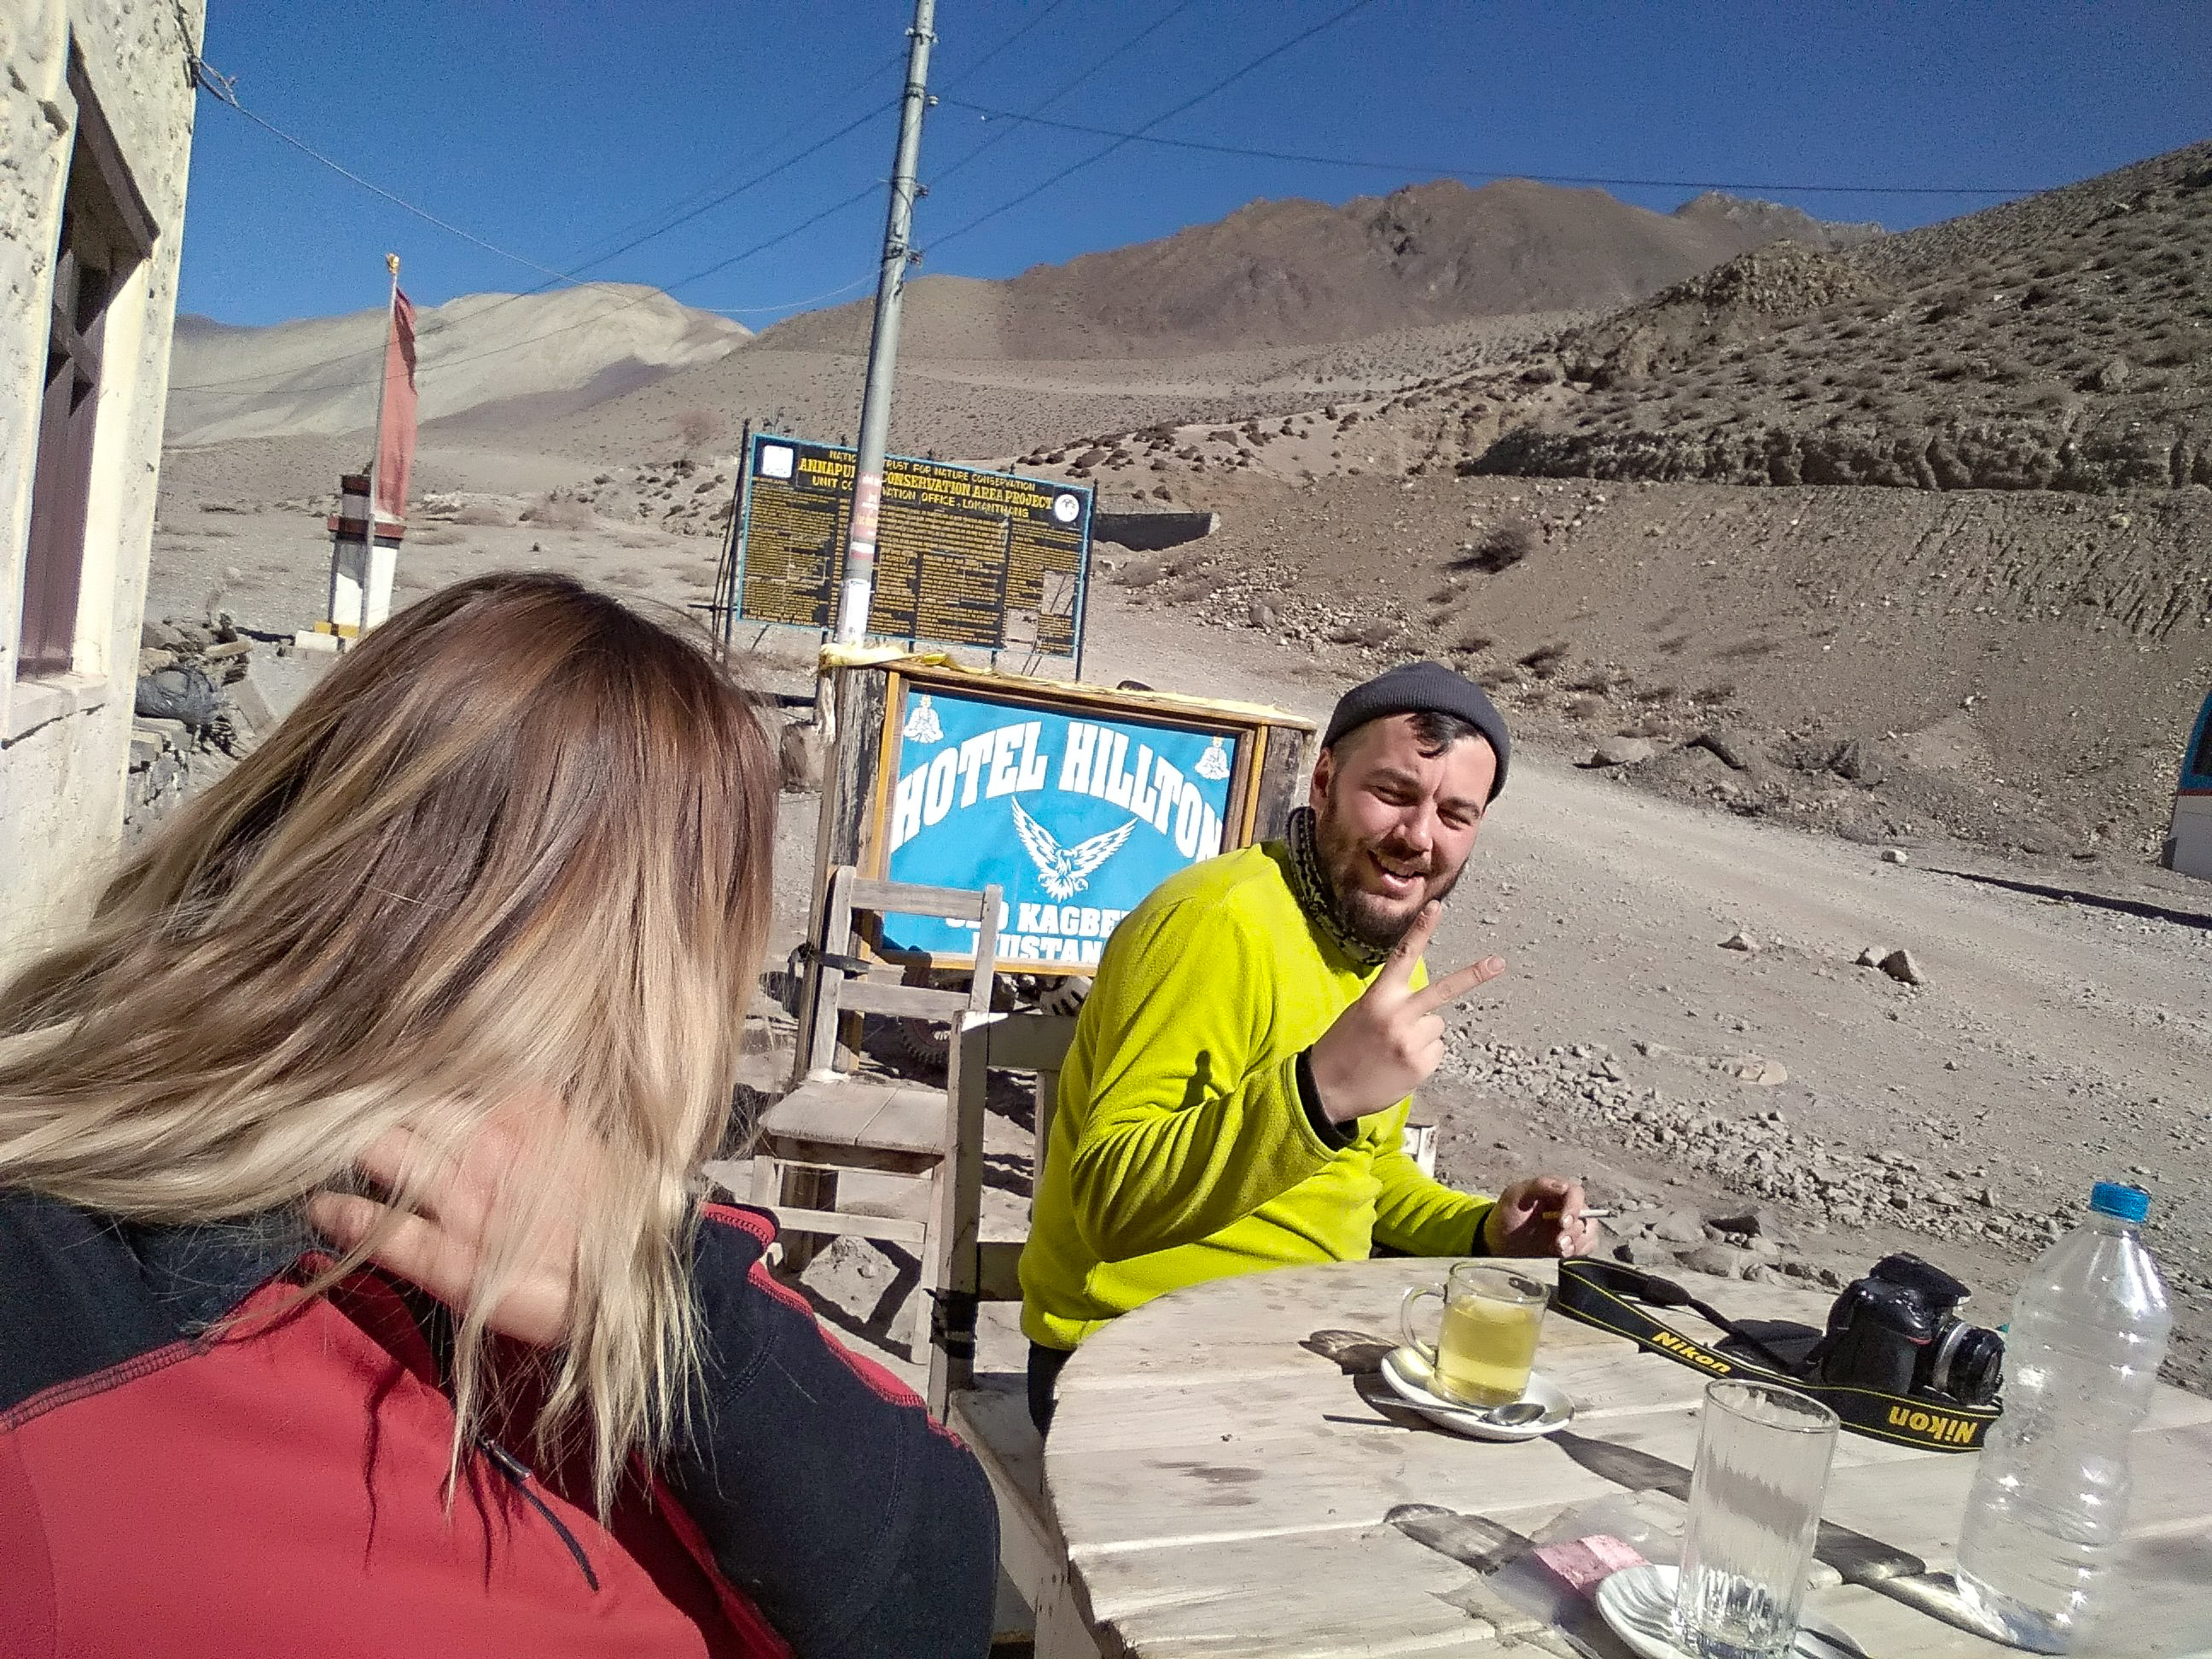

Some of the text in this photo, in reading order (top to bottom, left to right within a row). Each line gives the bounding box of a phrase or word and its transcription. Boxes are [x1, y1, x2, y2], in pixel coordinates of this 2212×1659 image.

[798, 457, 856, 478] ANNAPU
[972, 483, 1004, 502] AREA
[1004, 490, 1053, 509] PROJECT
[812, 474, 838, 488] UNIT
[830, 451, 1036, 492] NATIO TRUST FOR NATURE CONSERVATION
[891, 720, 1224, 864] HOTEL HILLTON
[1017, 902, 1134, 938] KAGBE
[971, 931, 1108, 963] USTAN
[1651, 1331, 1732, 1373] Nikon
[1889, 1406, 1978, 1443] Nikon
